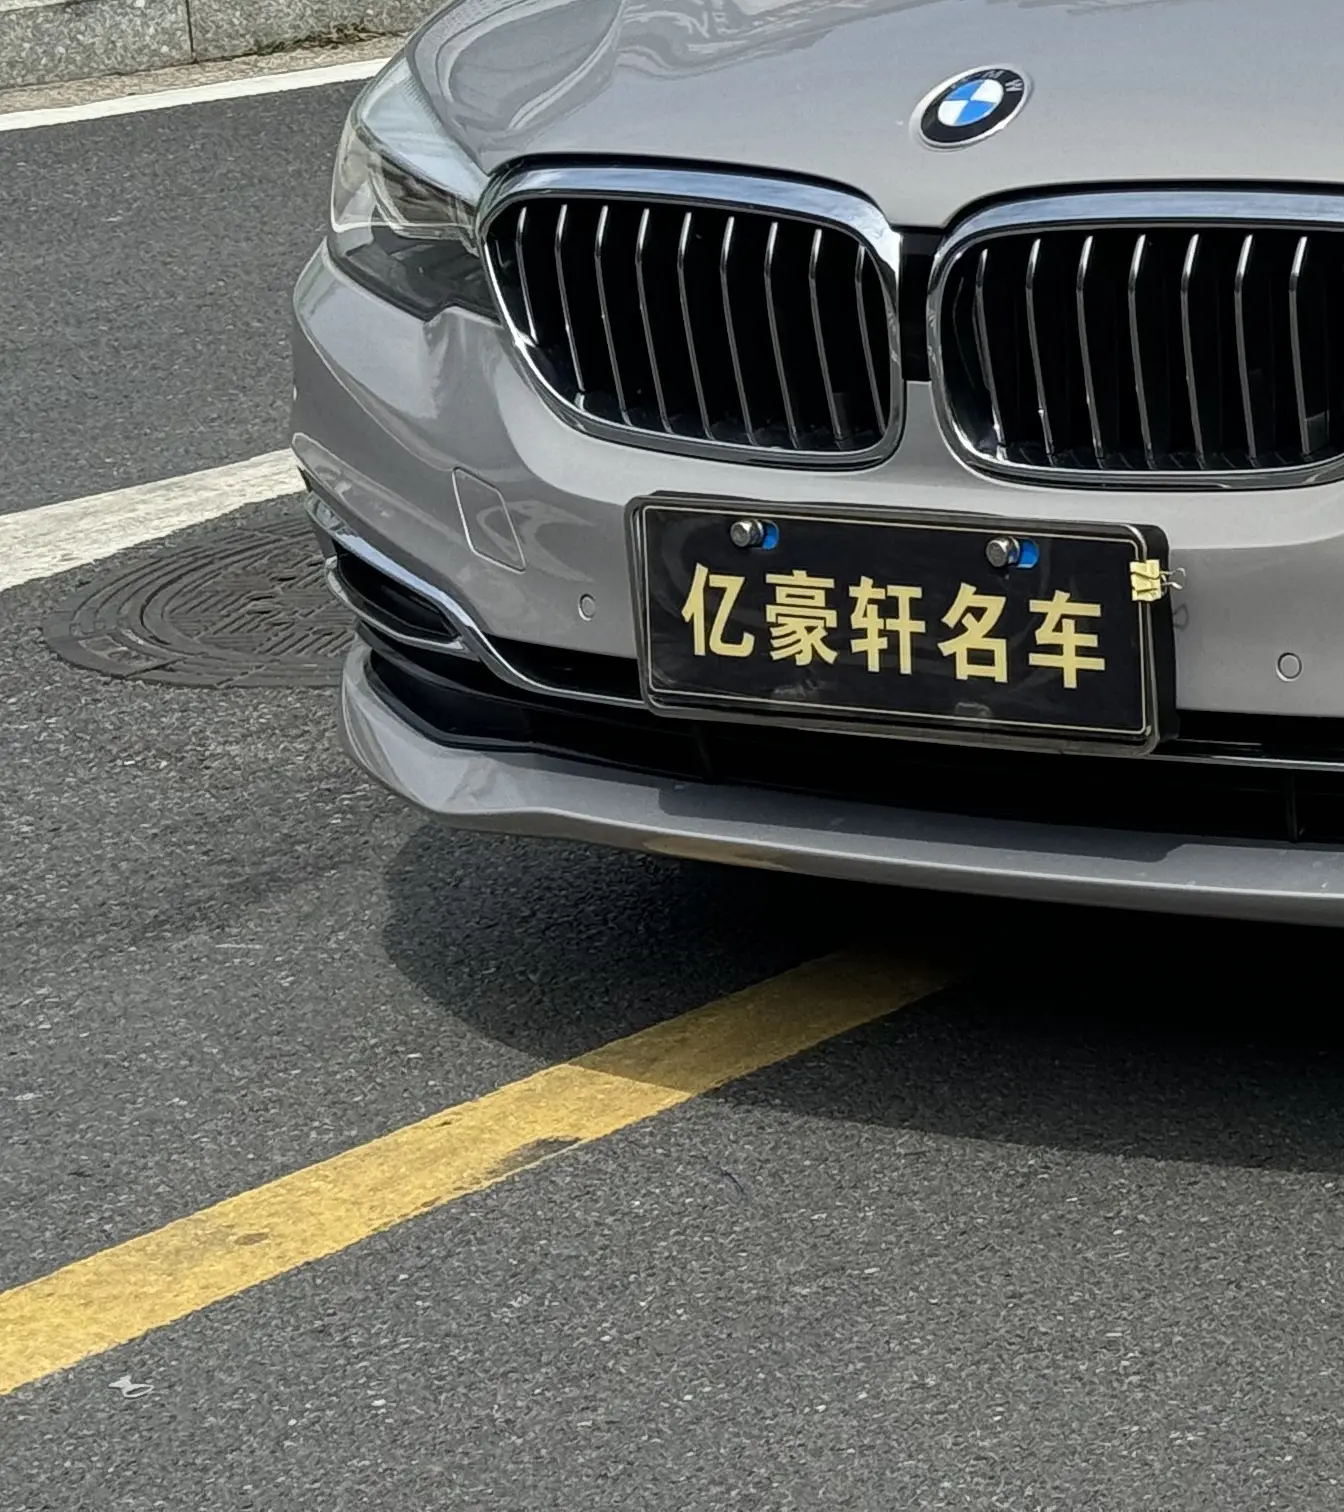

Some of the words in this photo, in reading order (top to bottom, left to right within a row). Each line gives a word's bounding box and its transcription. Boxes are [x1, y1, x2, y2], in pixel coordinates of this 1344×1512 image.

[681, 562, 1106, 689] 亿豪轩名车
